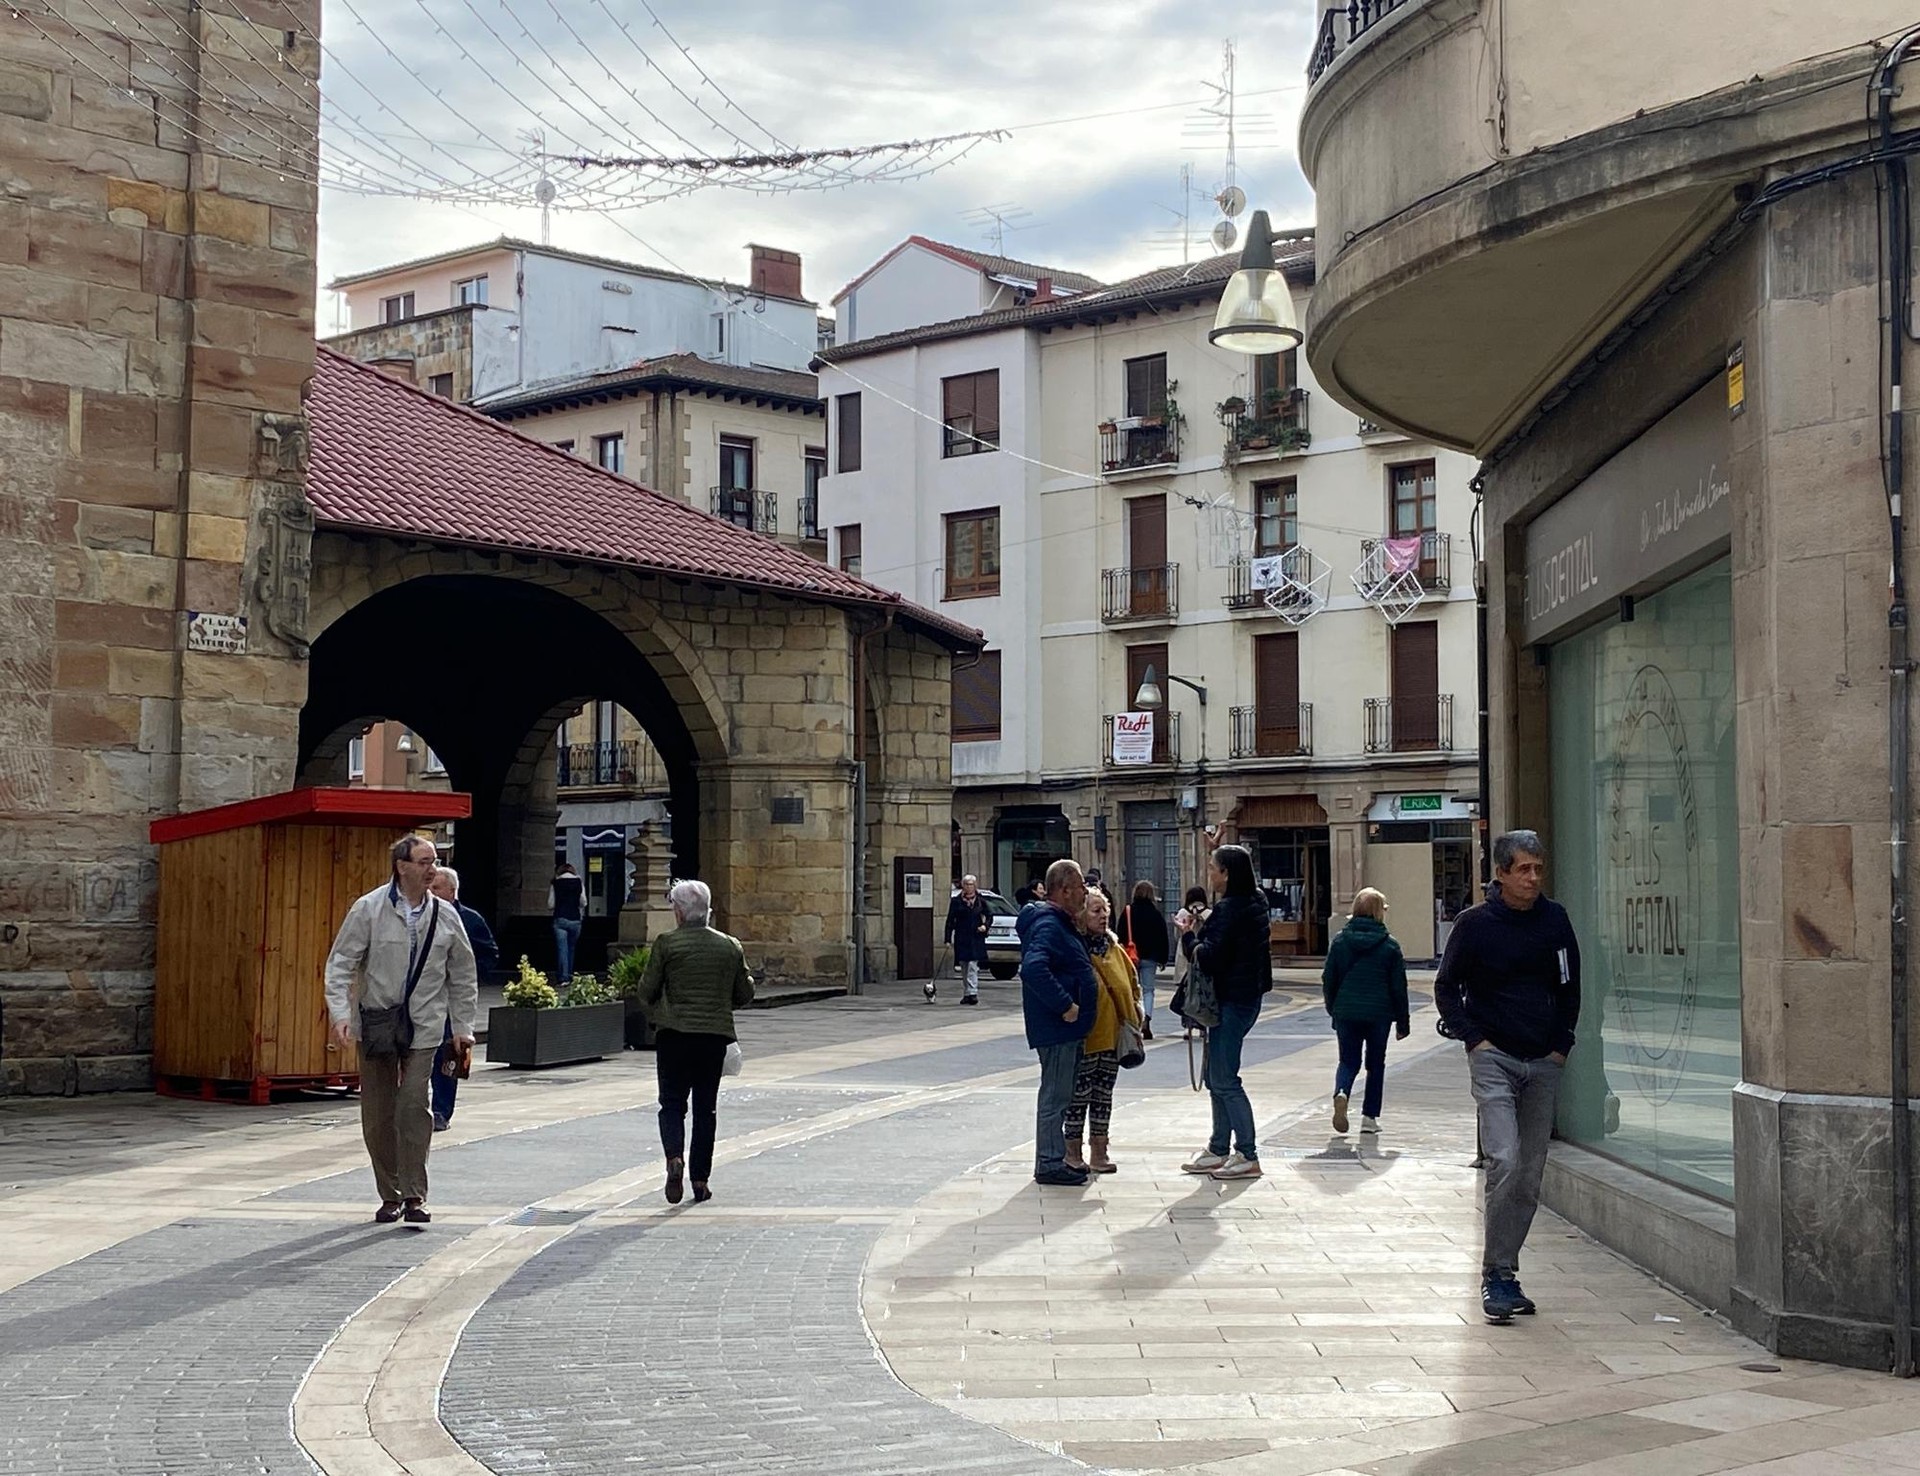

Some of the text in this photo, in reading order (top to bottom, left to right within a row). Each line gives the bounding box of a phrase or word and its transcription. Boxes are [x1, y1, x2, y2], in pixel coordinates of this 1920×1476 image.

[201, 617, 239, 629] PLAZA
[213, 629, 227, 637] DE
[1403, 797, 1440, 809] ERIKA
[1624, 825, 1661, 886] PLUS
[1625, 896, 1685, 955] DENTAL
